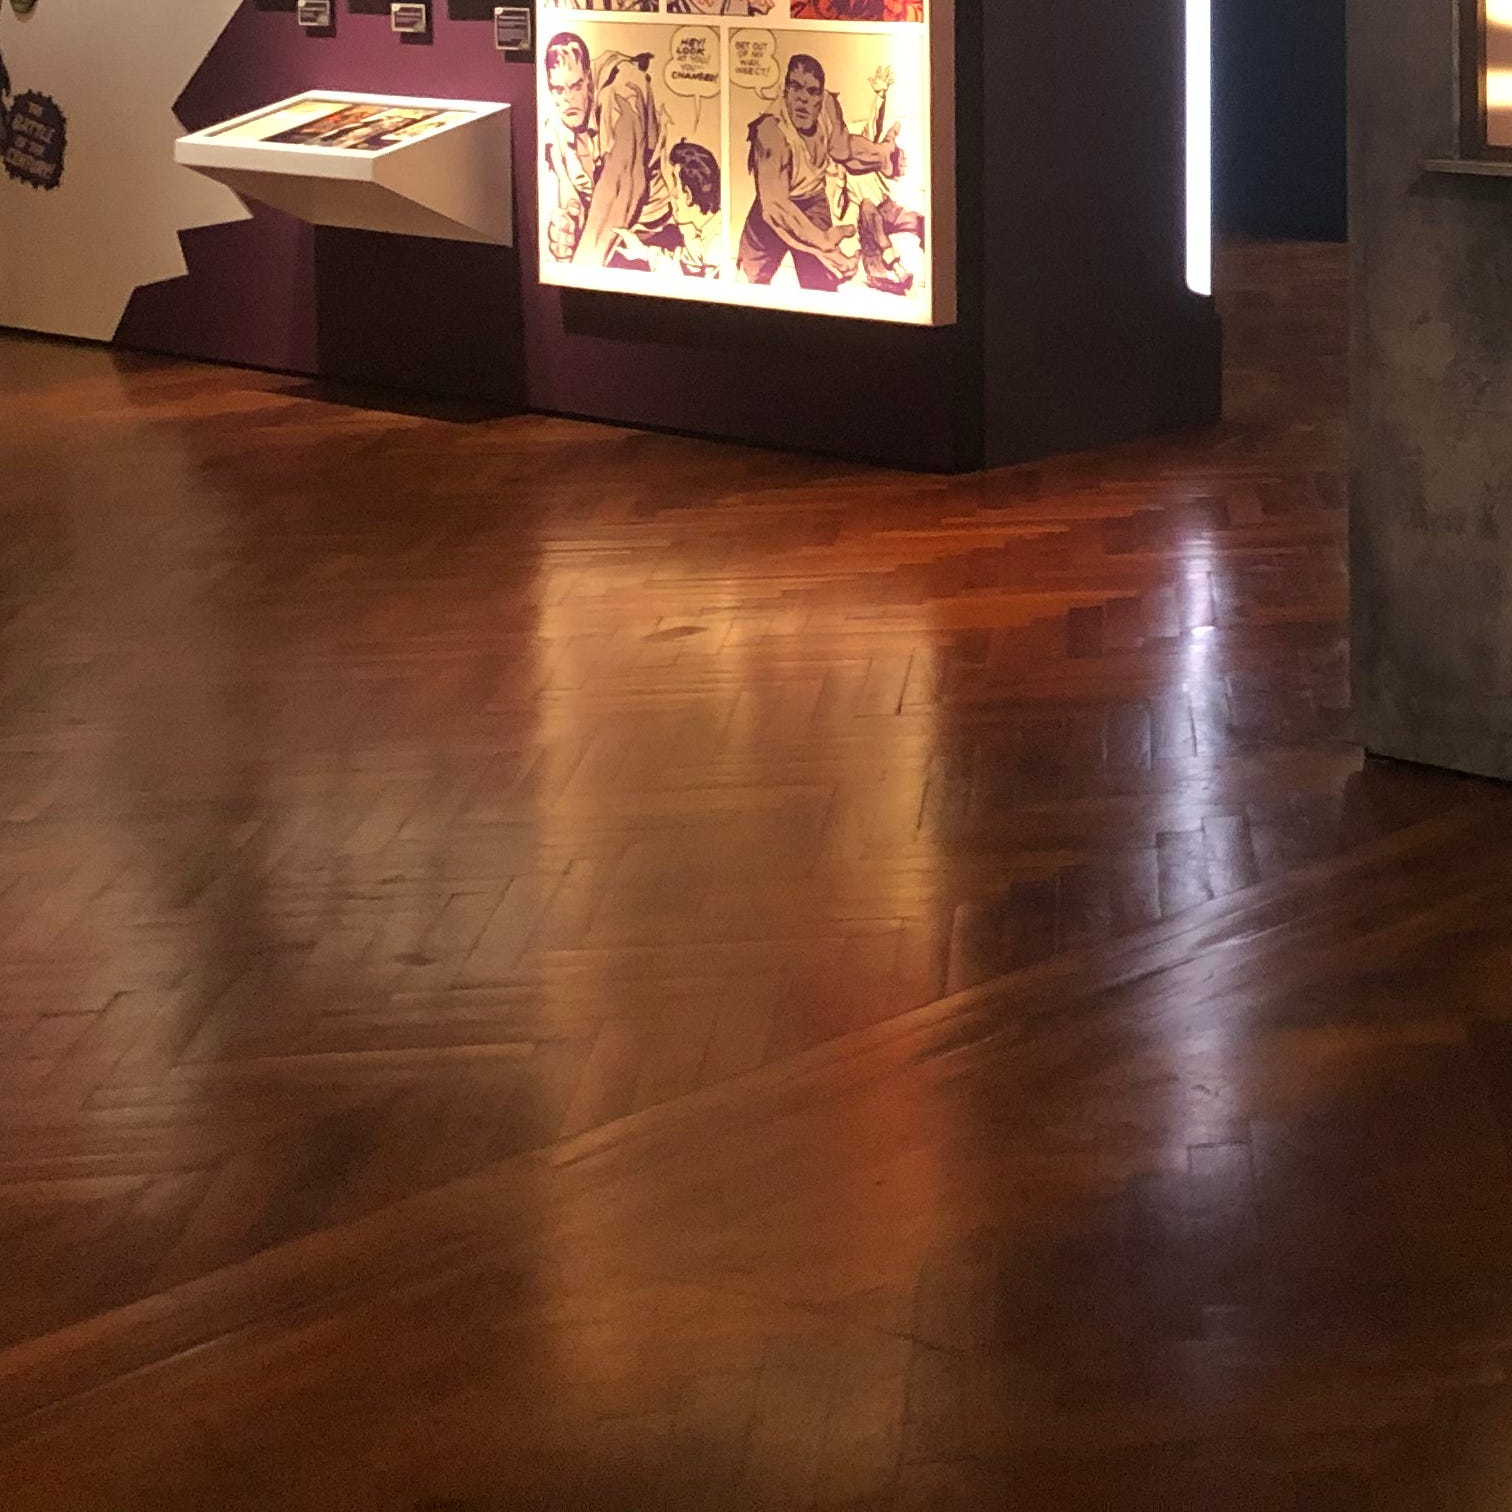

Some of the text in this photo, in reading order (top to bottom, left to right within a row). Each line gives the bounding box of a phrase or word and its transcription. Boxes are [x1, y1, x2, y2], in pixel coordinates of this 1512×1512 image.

[680, 37, 707, 49] HEY!
[735, 41, 768, 51] GET OUT
[676, 47, 706, 57] LOOK
[735, 66, 771, 77] INSECT!
